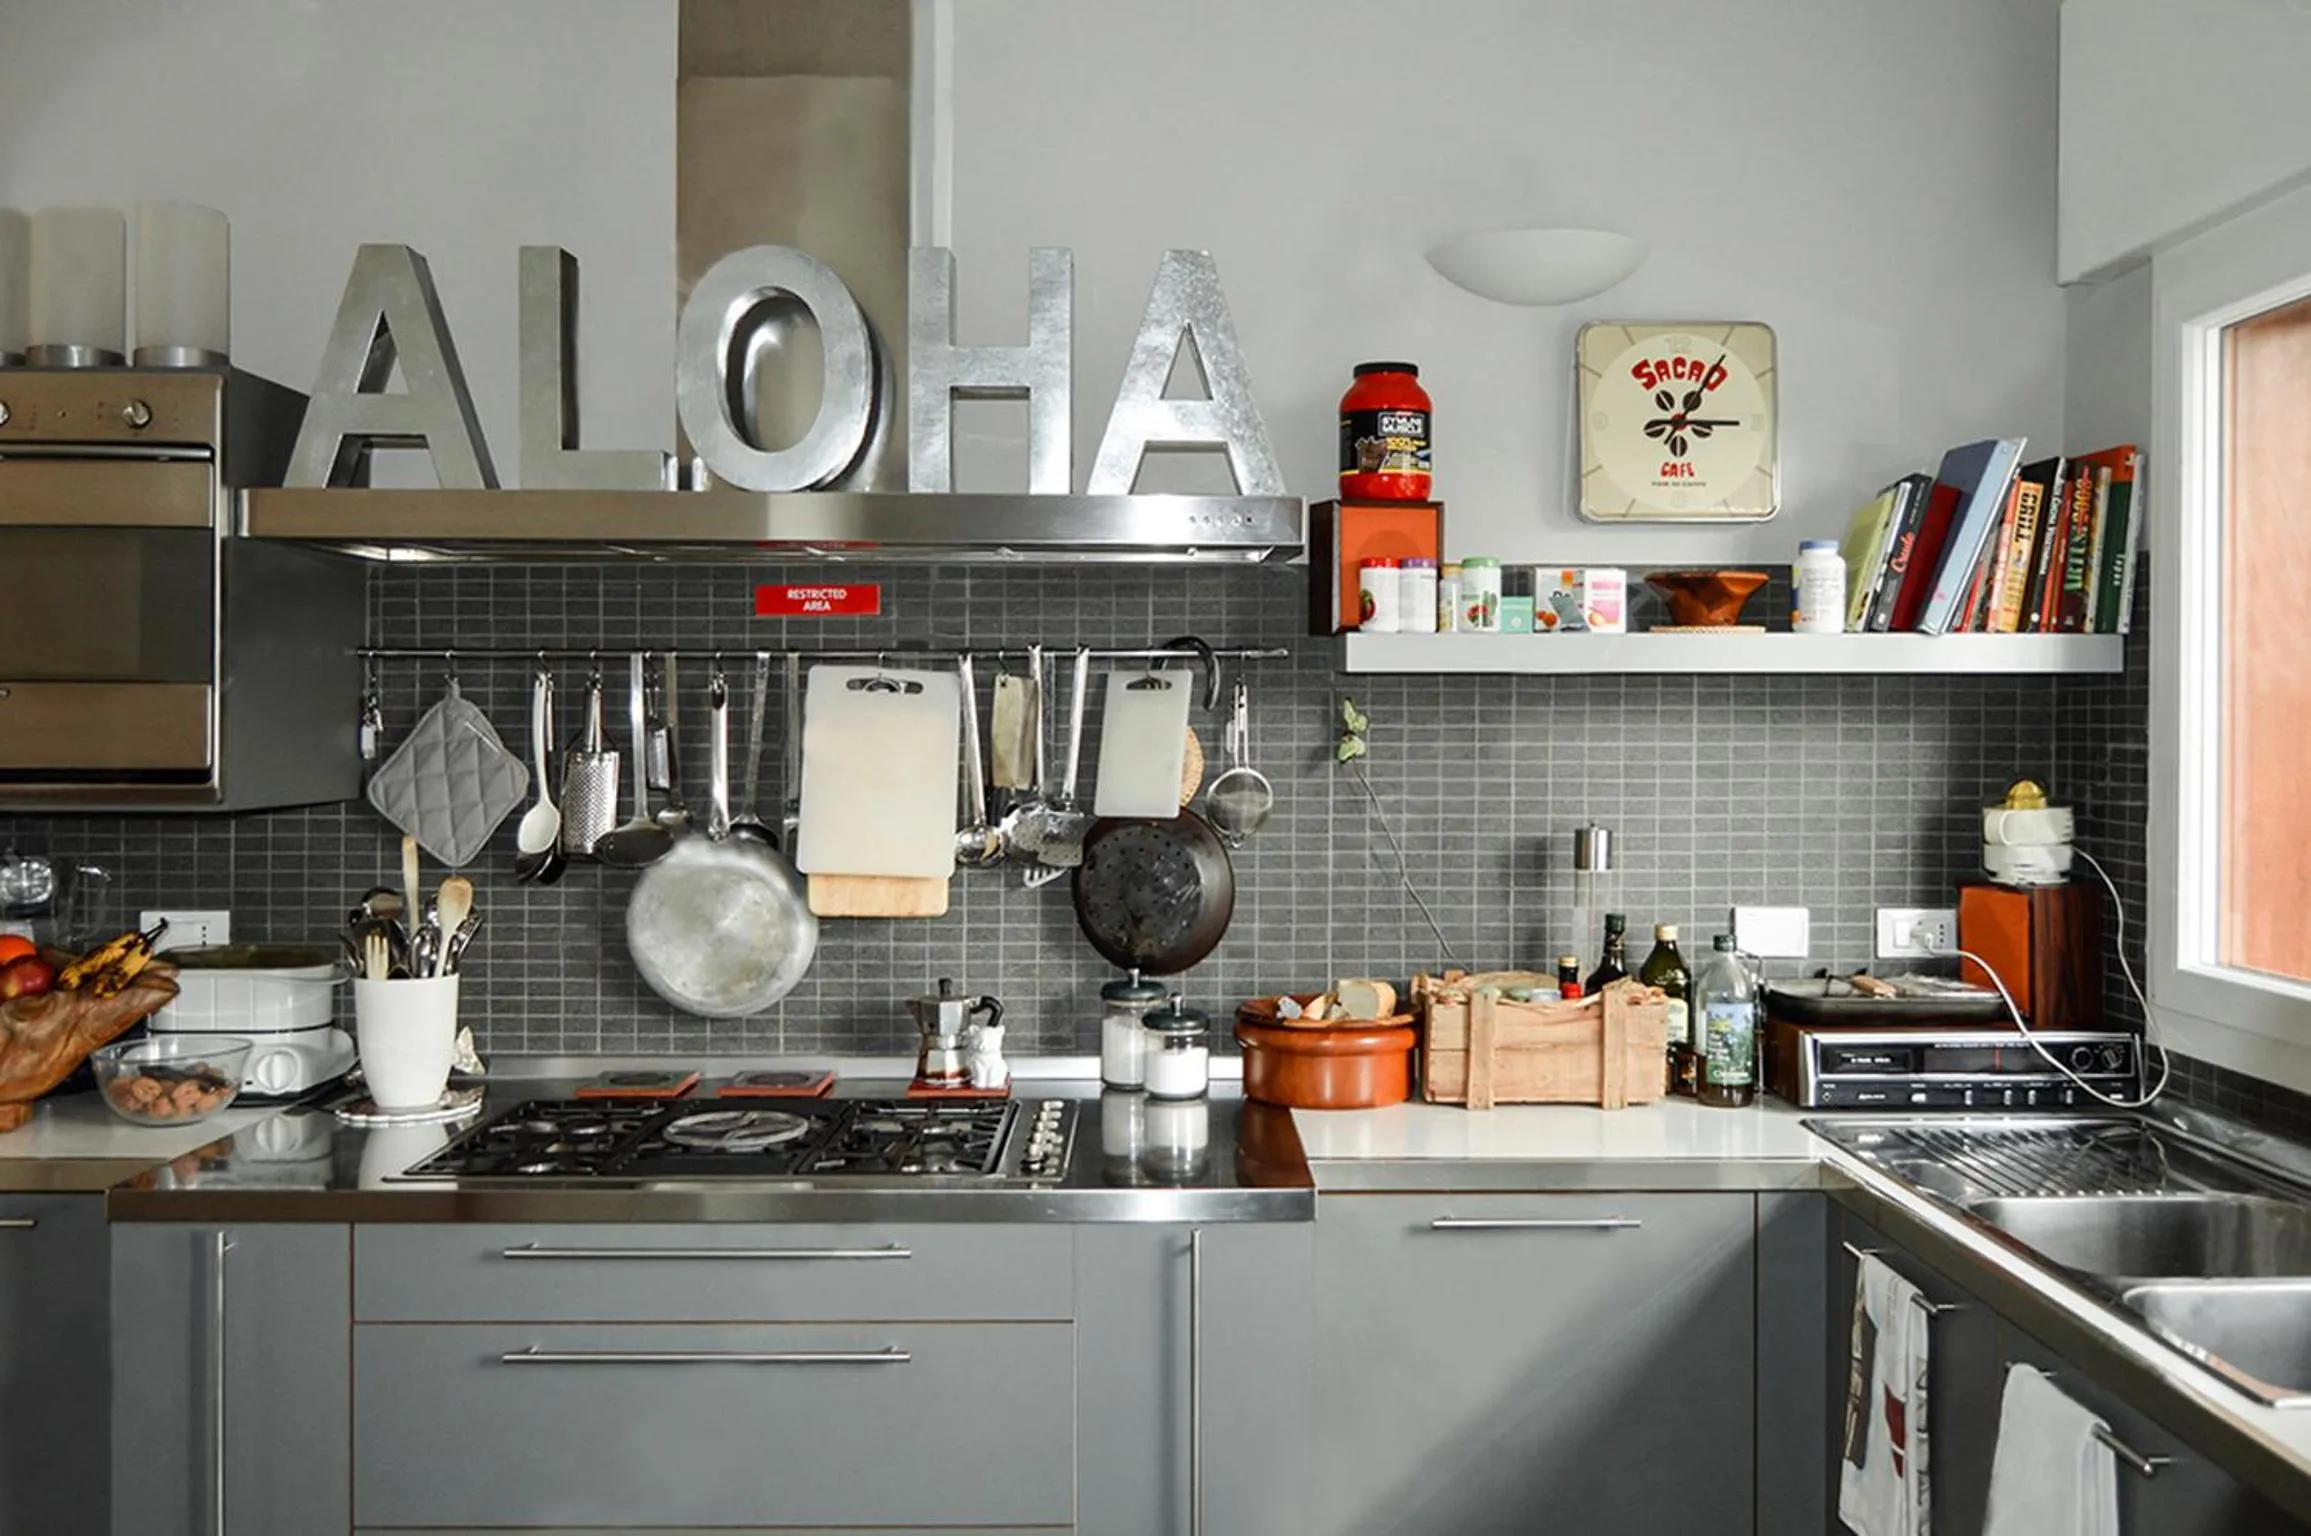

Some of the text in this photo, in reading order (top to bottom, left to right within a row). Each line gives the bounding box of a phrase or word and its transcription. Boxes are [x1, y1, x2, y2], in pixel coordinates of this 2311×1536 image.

[283, 244, 1289, 495] ALOHA
[787, 588, 848, 600] RESTRICTED
[803, 600, 832, 612] AREA
